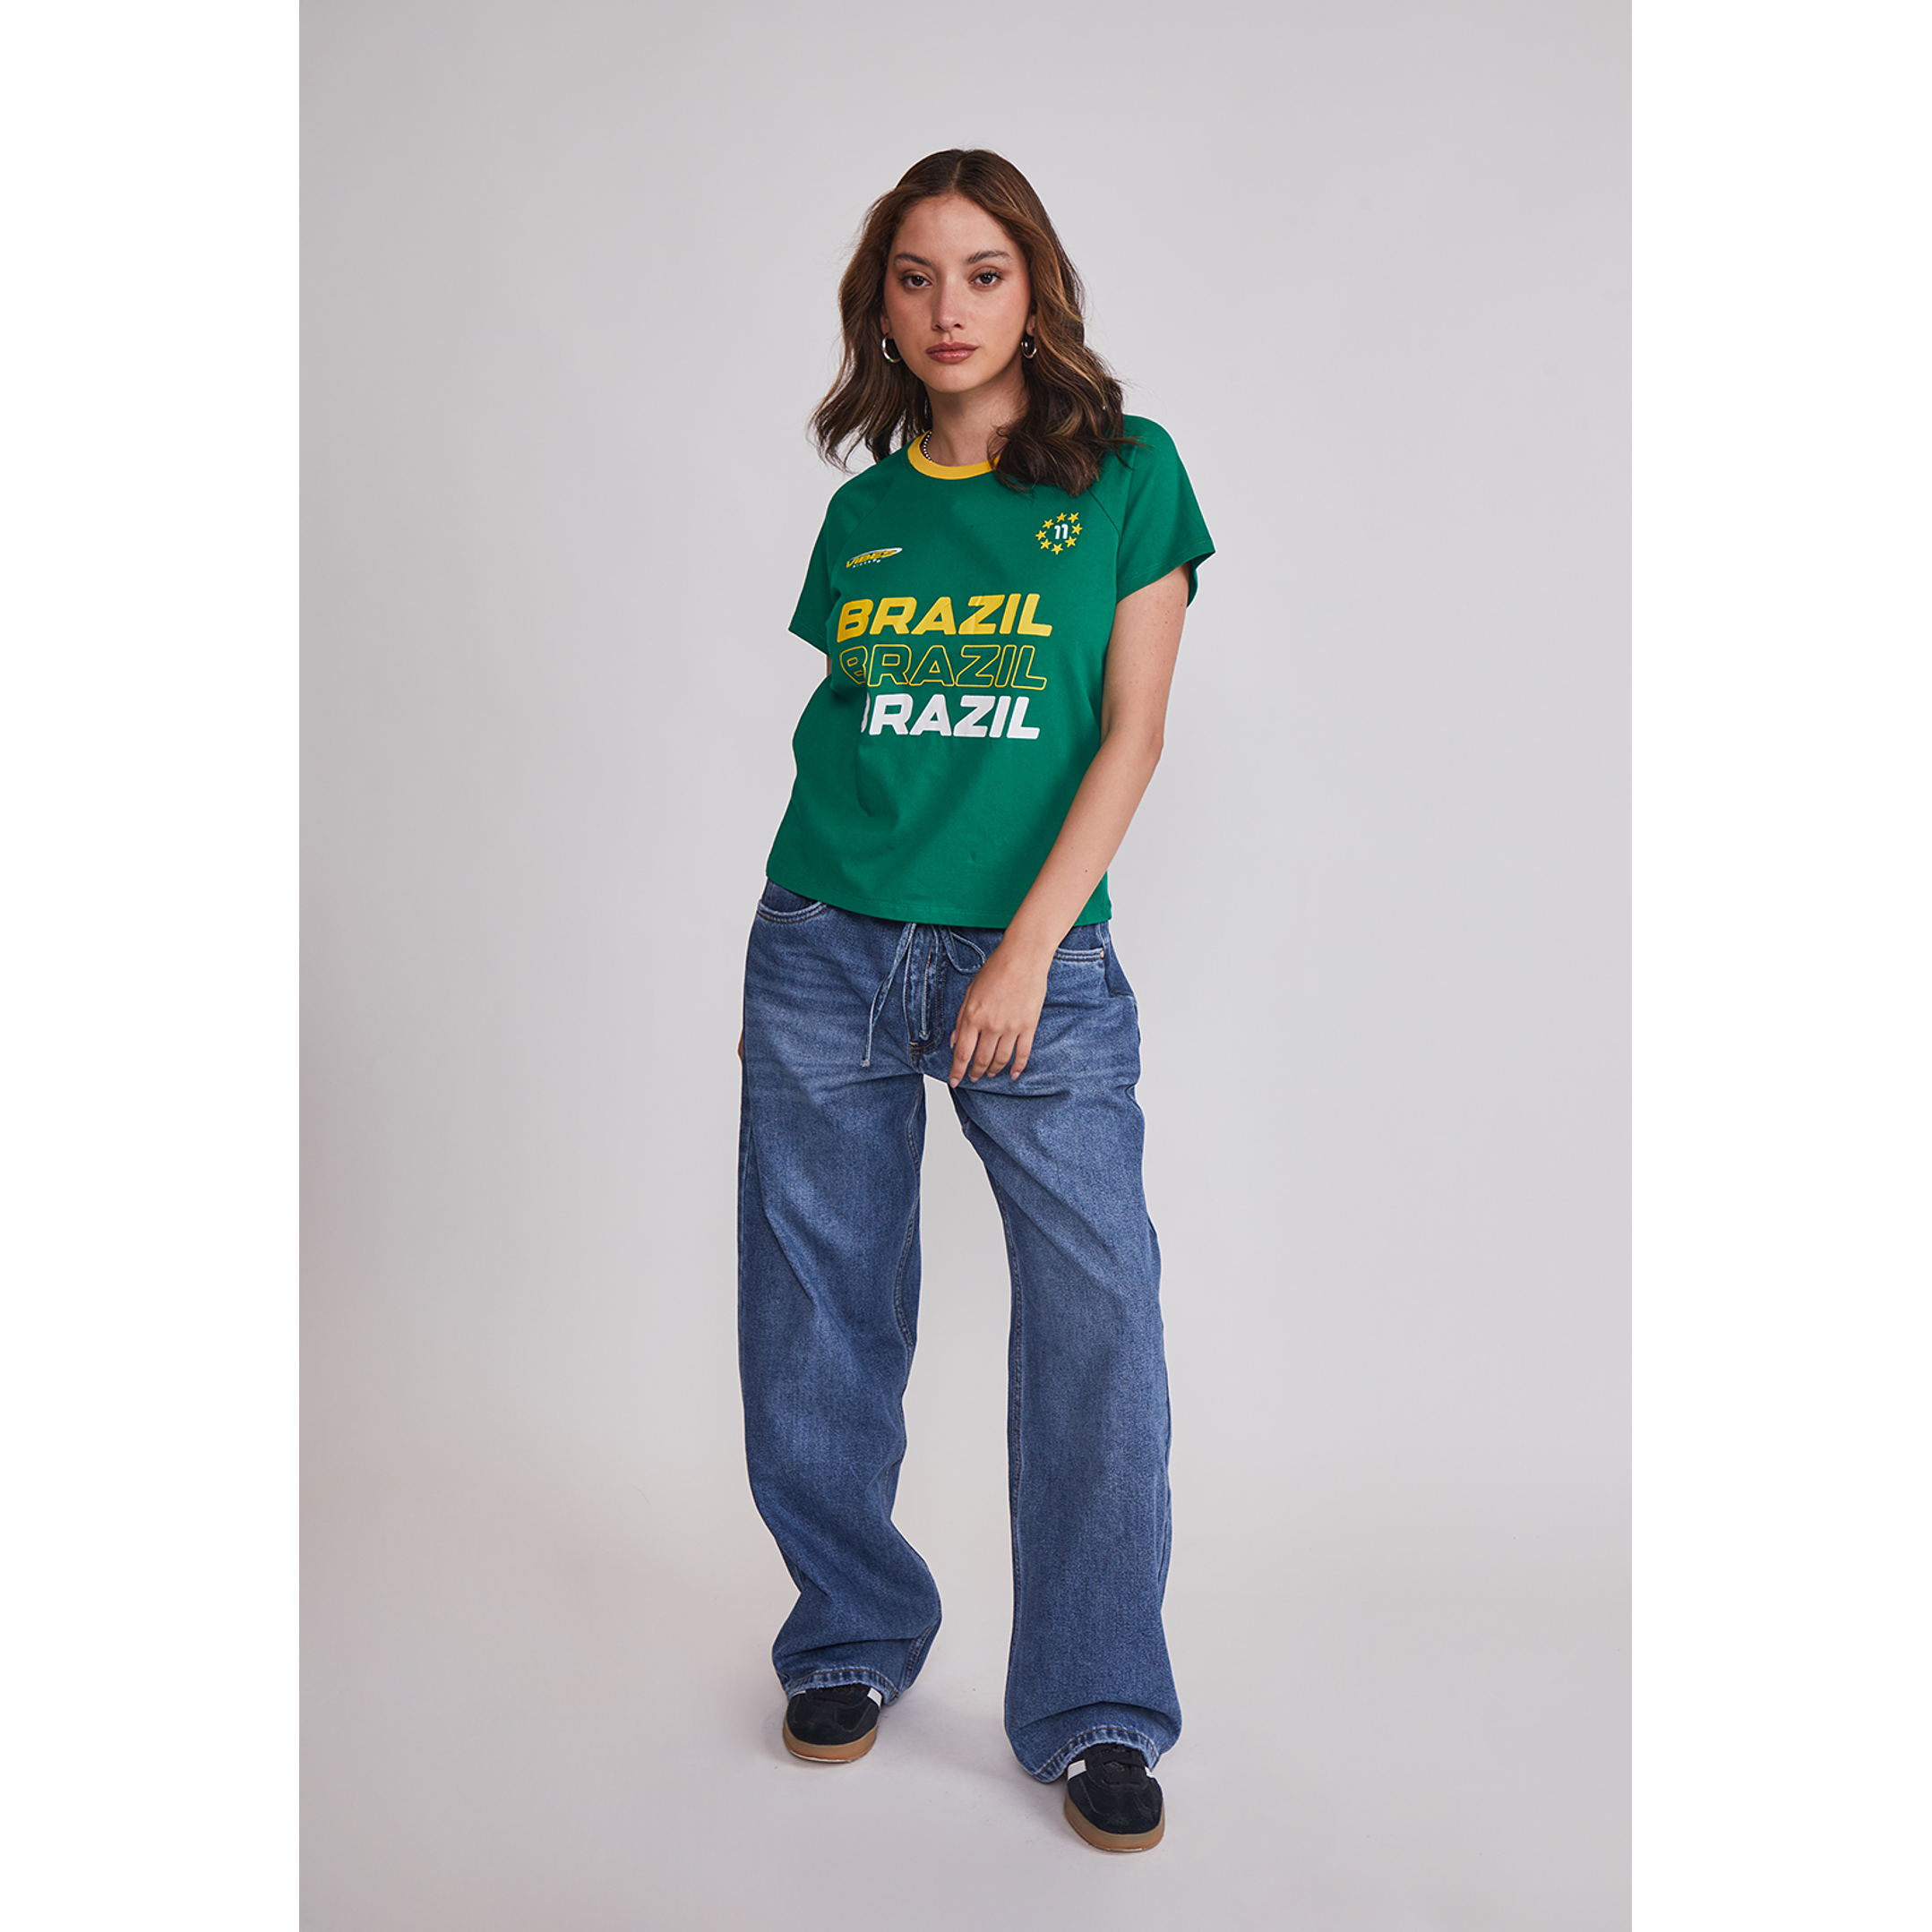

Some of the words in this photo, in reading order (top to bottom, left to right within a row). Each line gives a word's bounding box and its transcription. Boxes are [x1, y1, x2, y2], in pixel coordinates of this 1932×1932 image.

[1054, 523, 1069, 540] 11
[837, 593, 1052, 643] BRAZIL
[839, 644, 1047, 690] BRAZIL
[861, 692, 1040, 740] RAZIL
